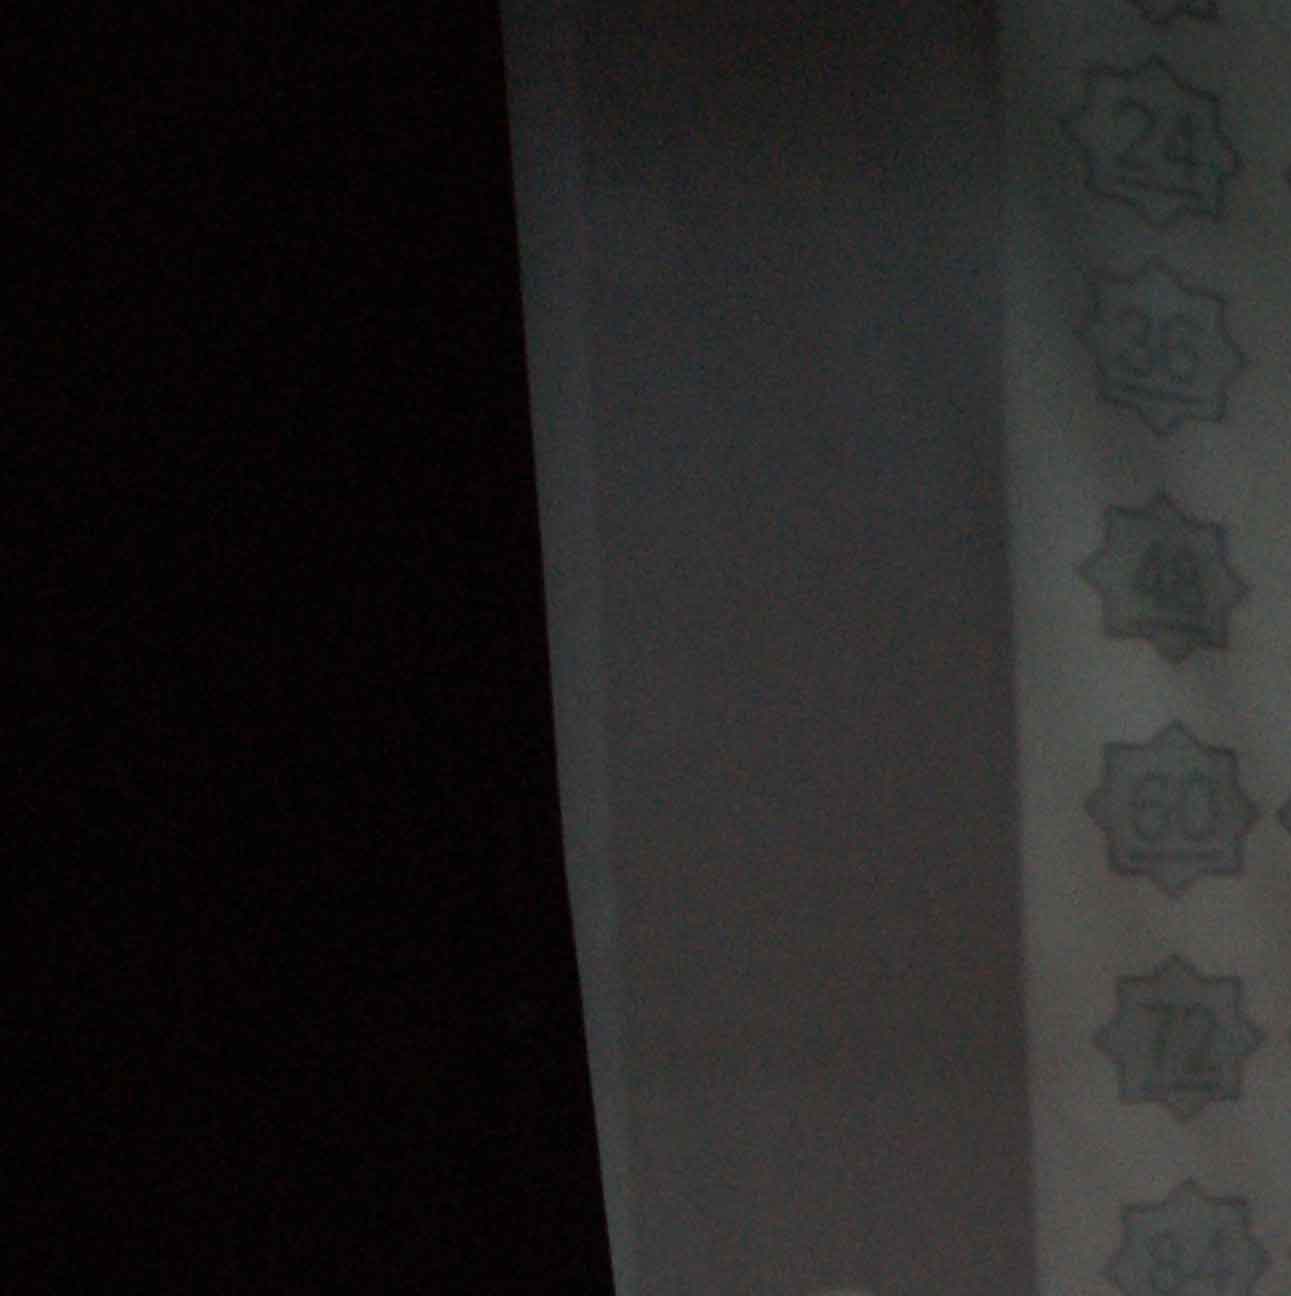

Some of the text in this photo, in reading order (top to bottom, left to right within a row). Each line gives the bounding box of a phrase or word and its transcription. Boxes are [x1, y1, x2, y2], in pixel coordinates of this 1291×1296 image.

[1114, 98, 1196, 178] 24
[1118, 305, 1199, 383] 36
[1133, 772, 1218, 842] 60
[1141, 1001, 1217, 1073] 72
[1150, 1230, 1232, 1296] 84
